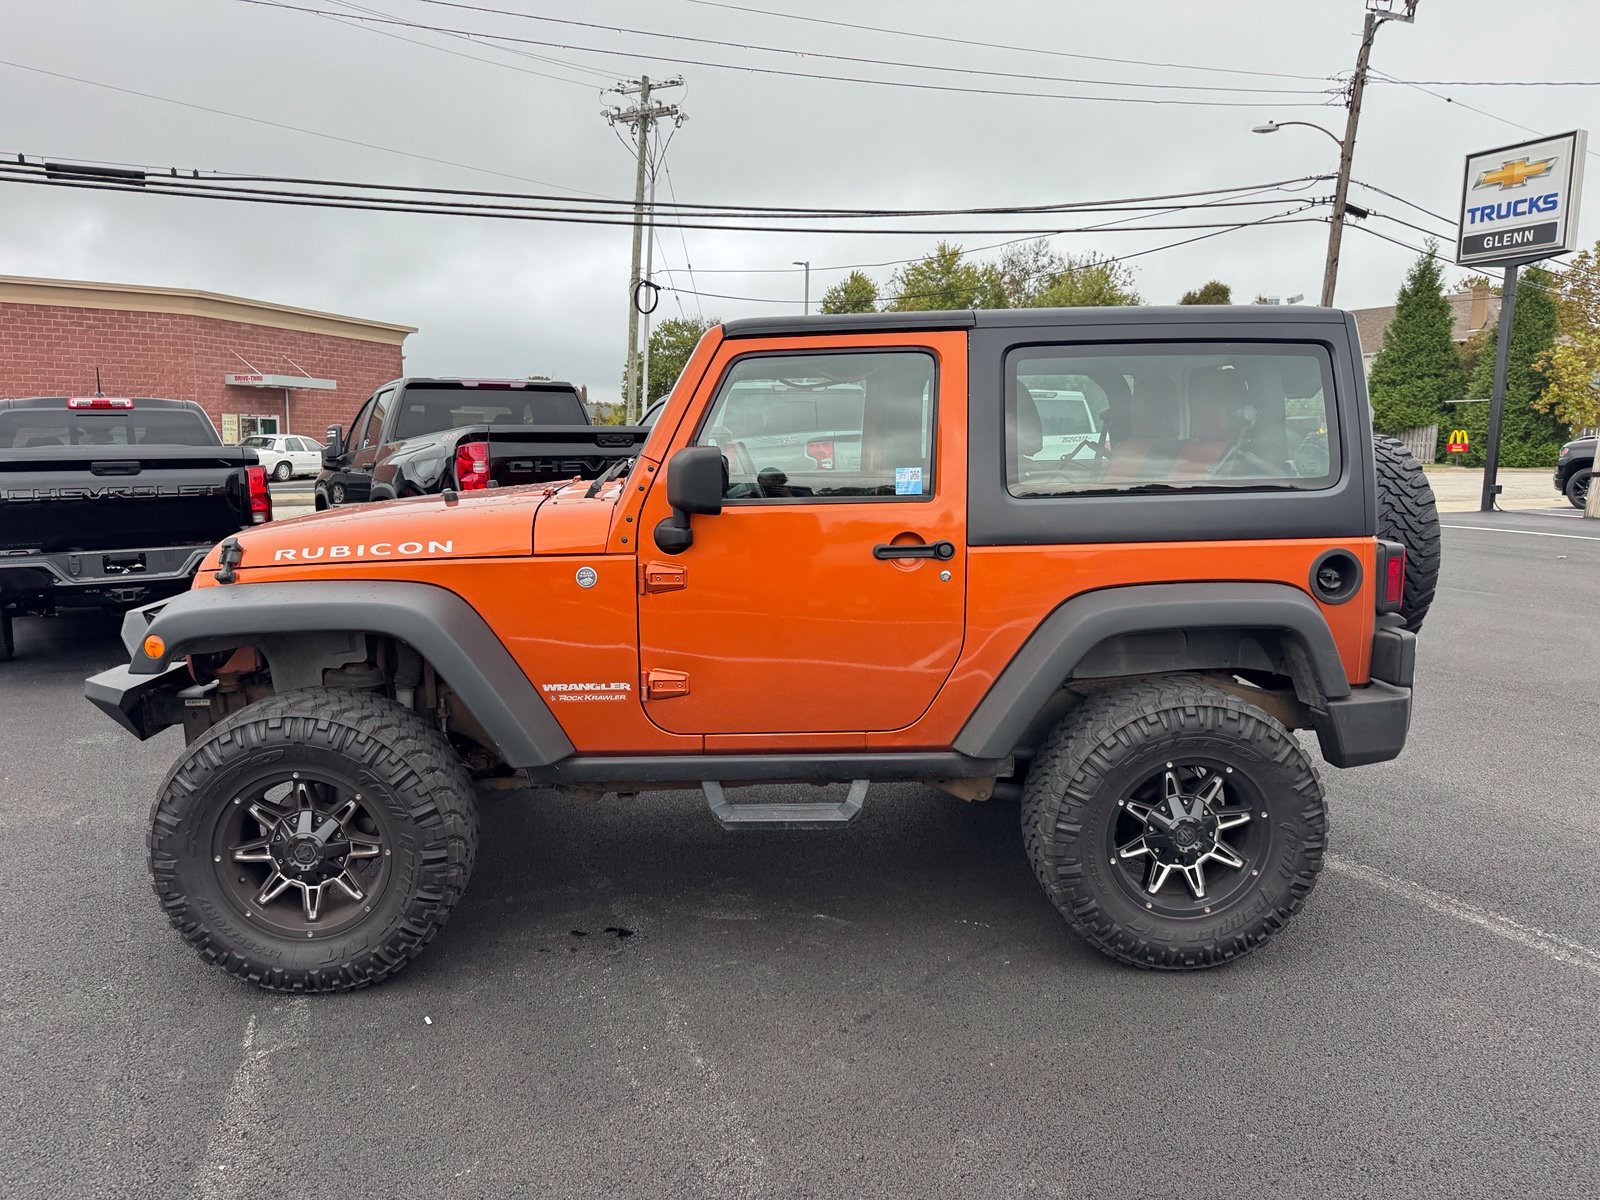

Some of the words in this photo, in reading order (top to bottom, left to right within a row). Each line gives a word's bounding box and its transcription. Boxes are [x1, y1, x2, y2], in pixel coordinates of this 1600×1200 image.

[1467, 192, 1559, 224] TRUCKS
[1483, 230, 1534, 249] GLENN
[7, 484, 220, 502] CHEVROLET
[274, 540, 453, 561] RUBICON
[542, 682, 632, 692] WRANGLER
